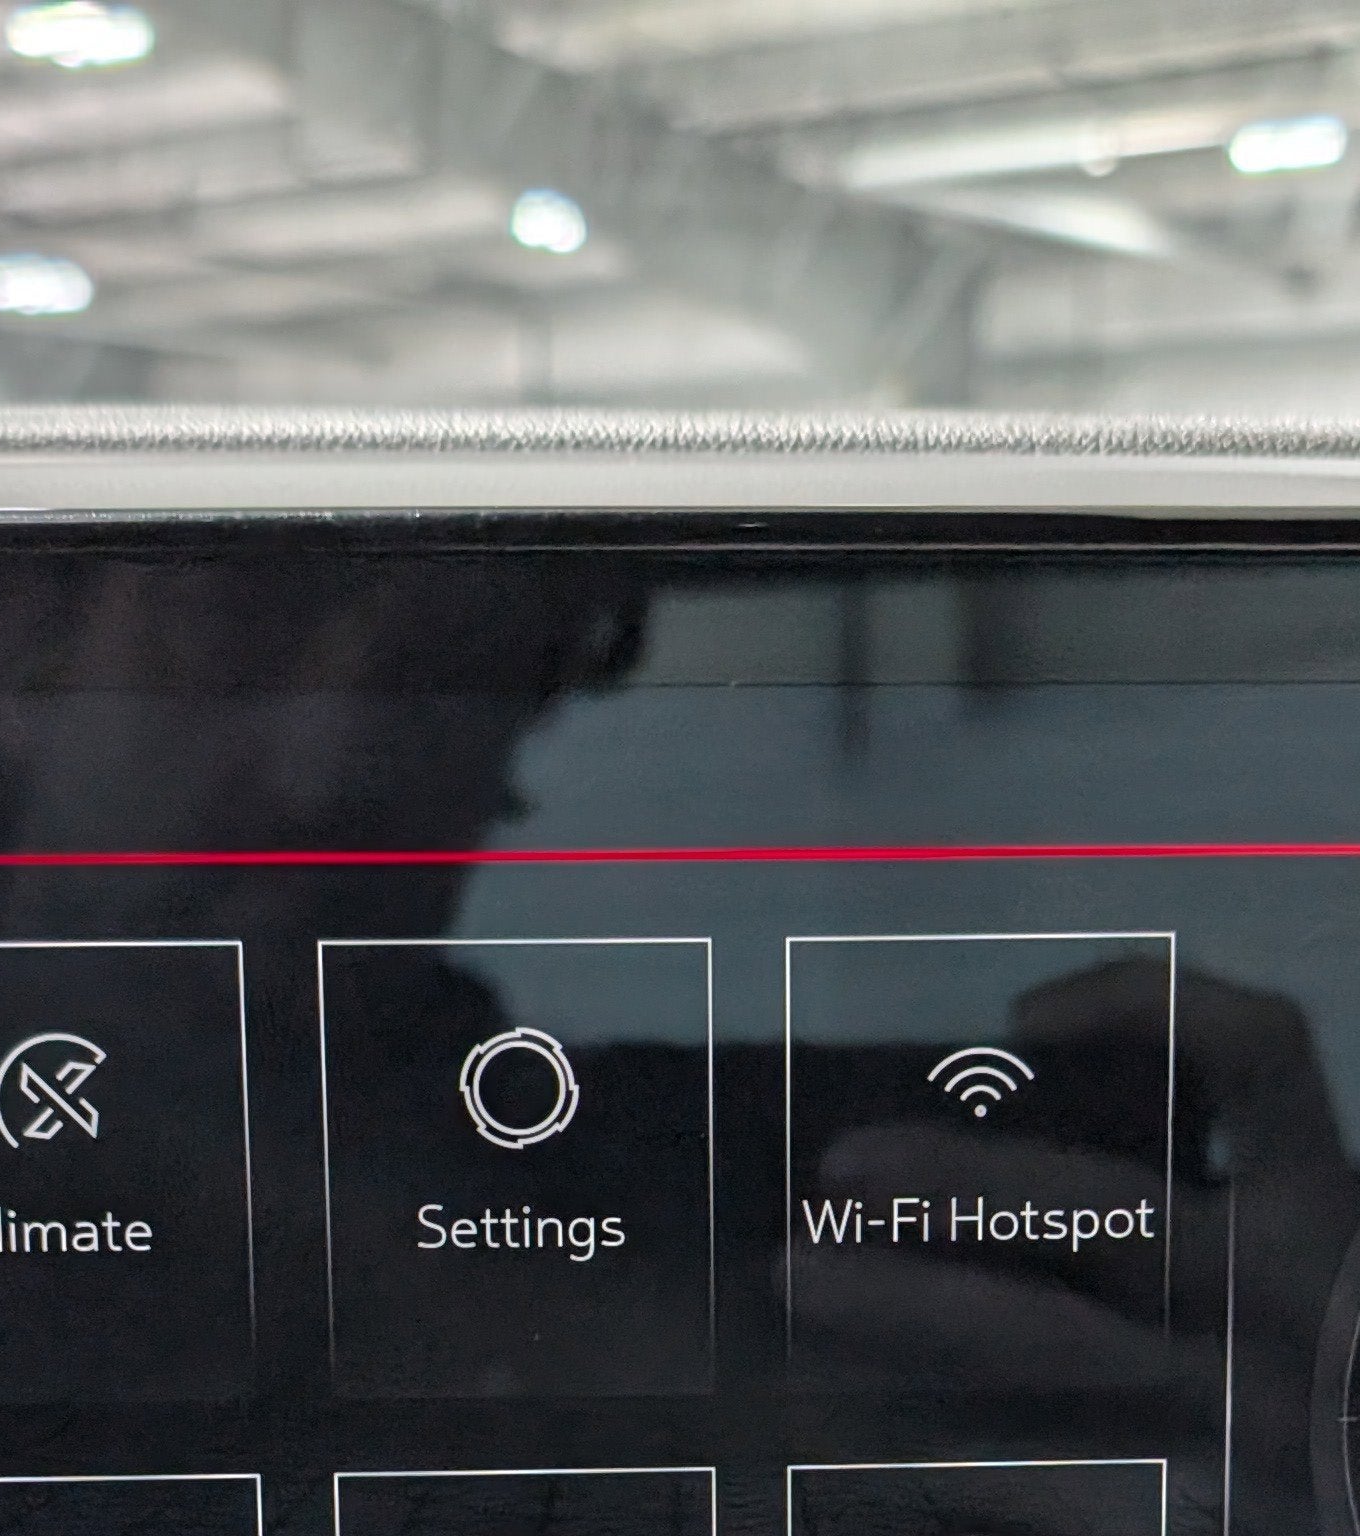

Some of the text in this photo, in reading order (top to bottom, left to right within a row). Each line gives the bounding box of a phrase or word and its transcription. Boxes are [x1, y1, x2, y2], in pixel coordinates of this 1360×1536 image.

[417, 1203, 626, 1262] Settings
[802, 1196, 1155, 1253] Wi-Fi Hotspot
